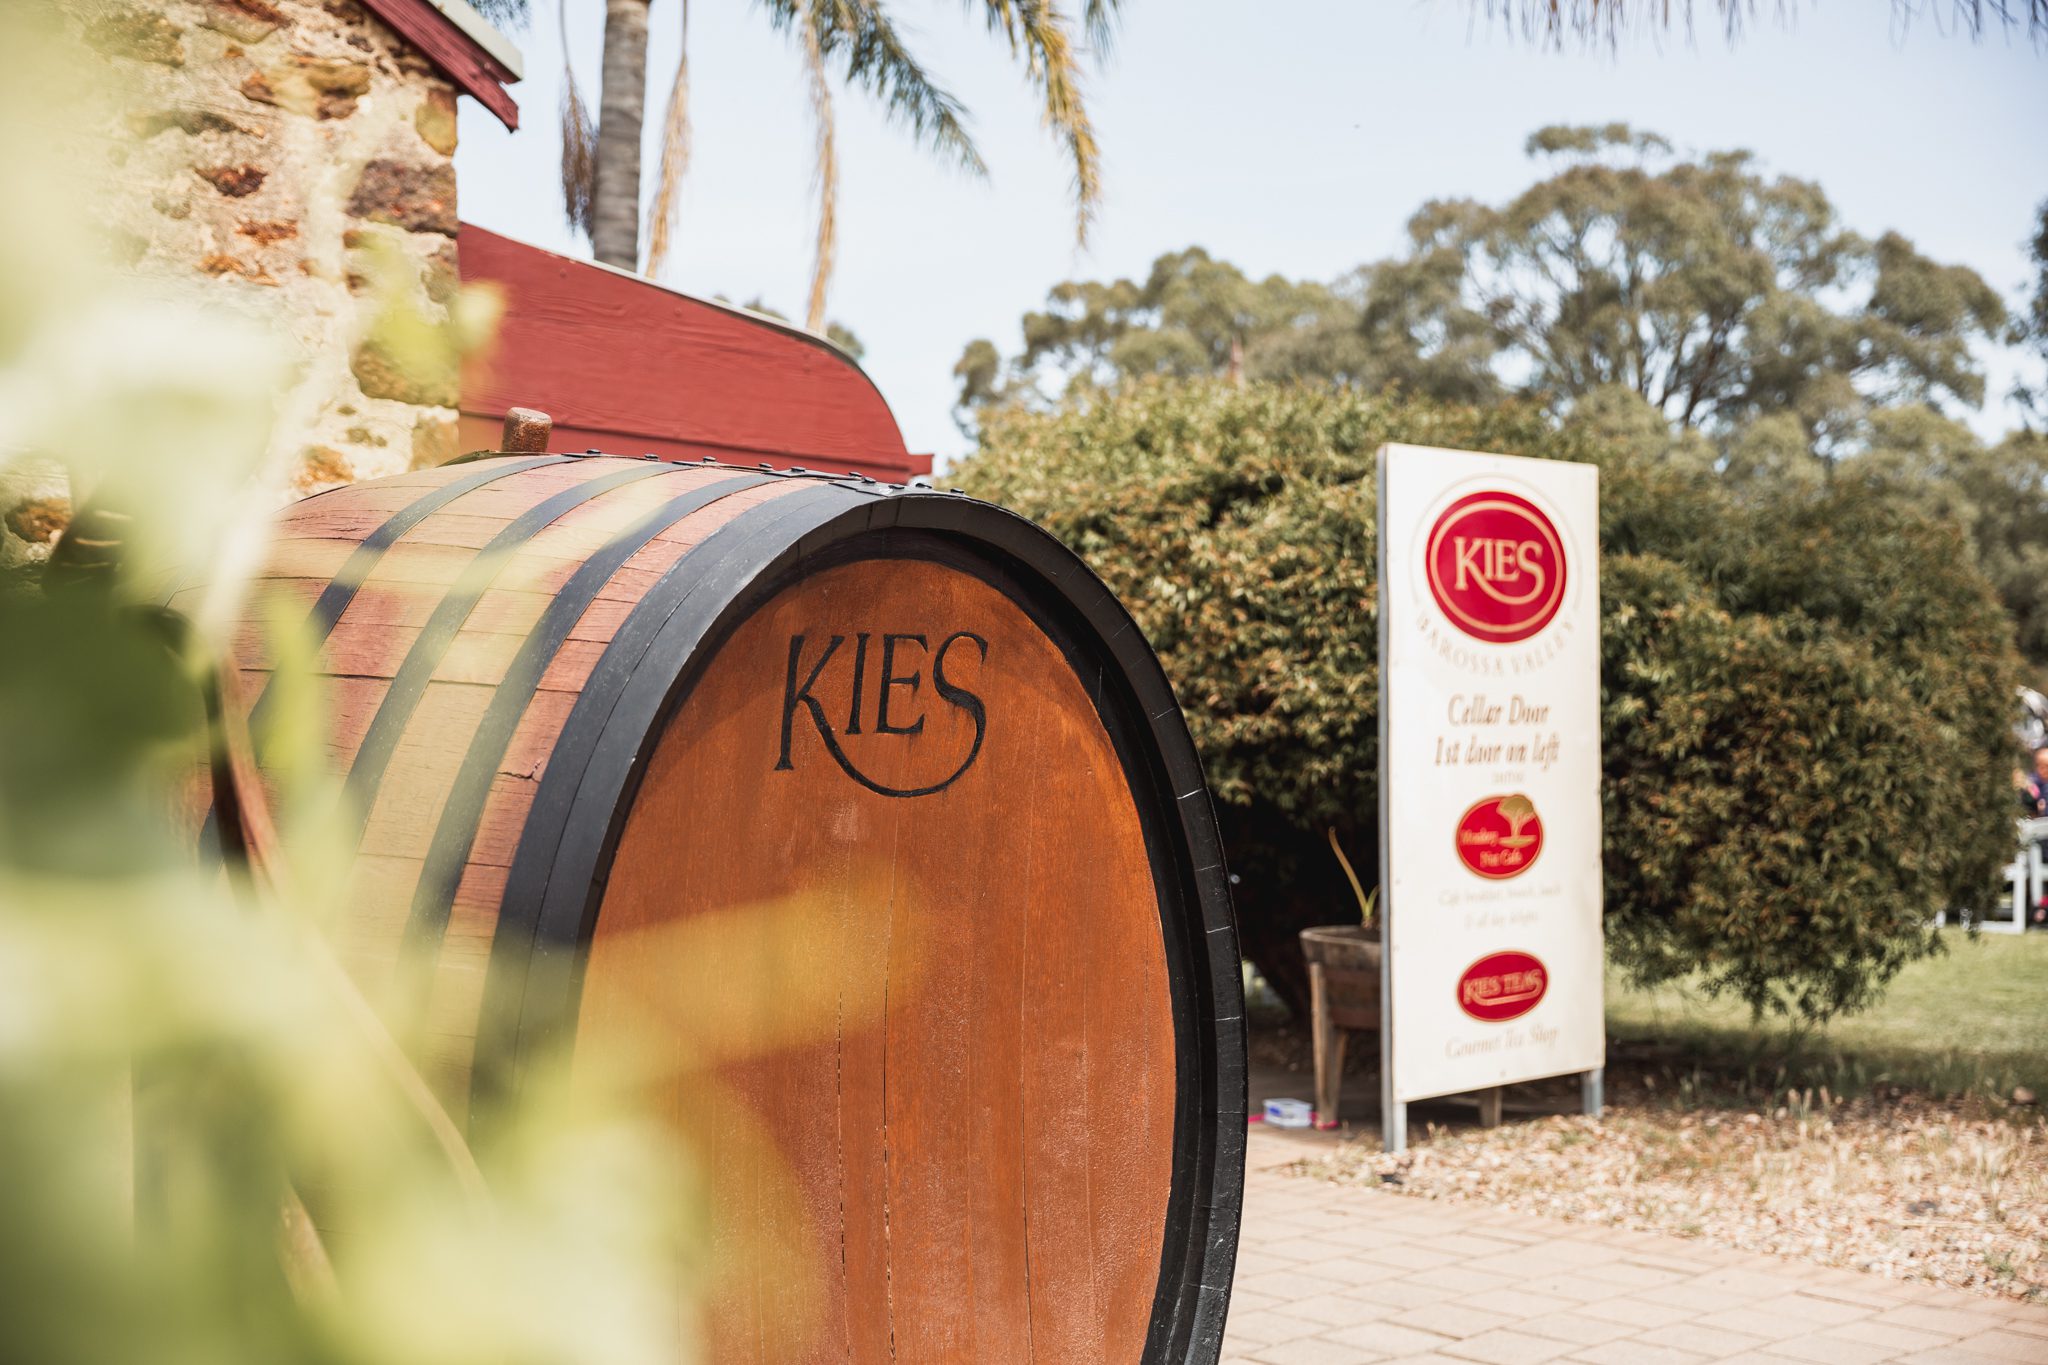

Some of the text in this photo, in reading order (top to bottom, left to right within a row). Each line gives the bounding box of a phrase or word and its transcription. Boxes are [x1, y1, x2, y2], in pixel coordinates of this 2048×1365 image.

[1453, 536, 1545, 605] KIES
[1416, 611, 1575, 676] BAROSSA VALLEY
[774, 631, 988, 798] KIES
[1448, 693, 1551, 726] Cellar Door
[1465, 733, 1503, 765] door
[1507, 742, 1527, 764] on
[1532, 731, 1560, 772] left
[1463, 974, 1502, 1006] KIES
